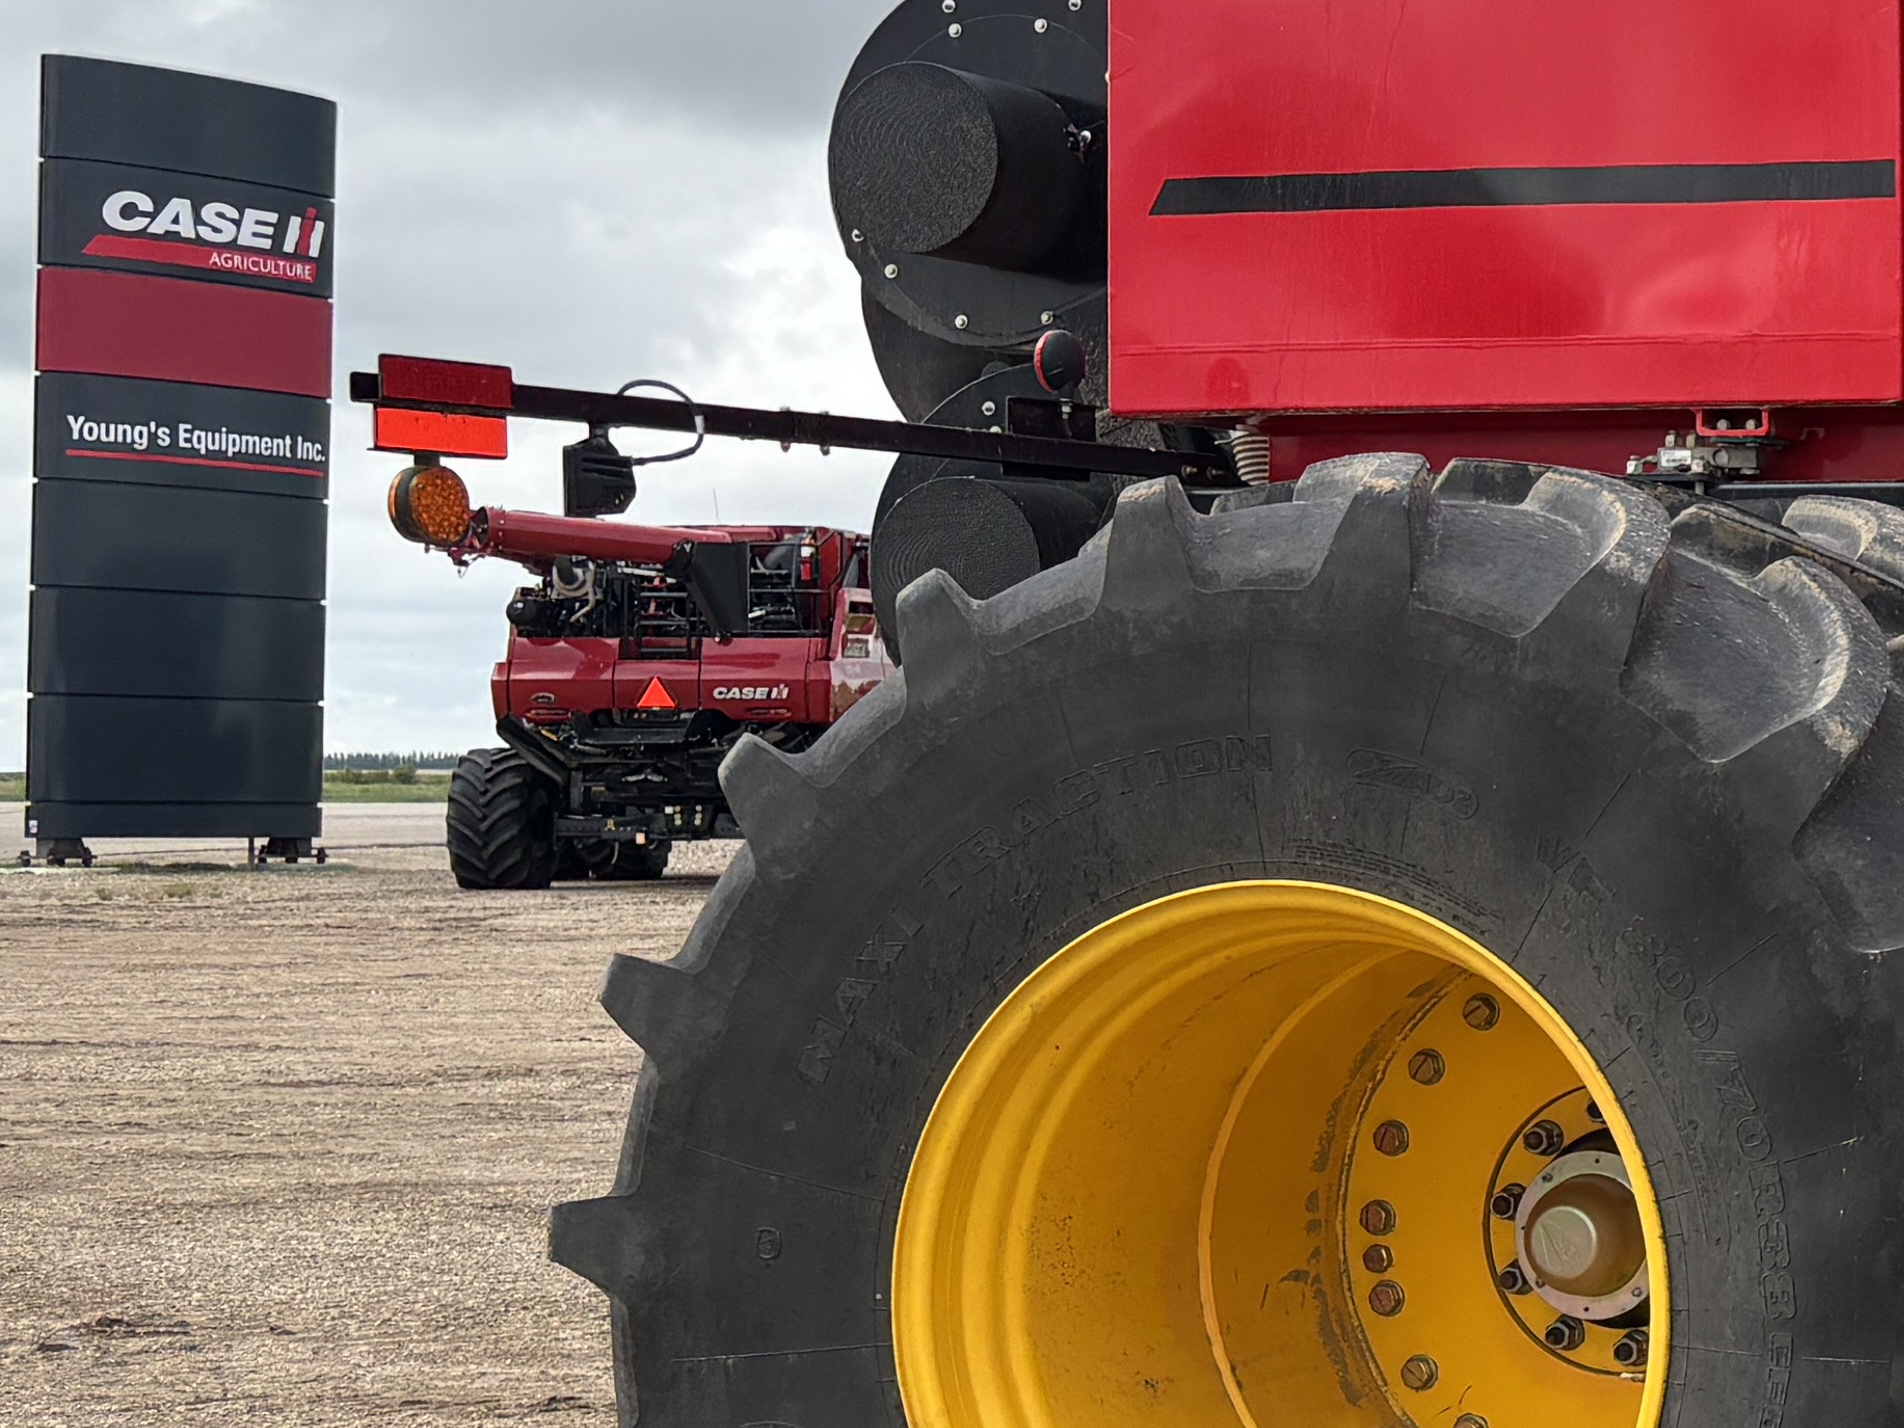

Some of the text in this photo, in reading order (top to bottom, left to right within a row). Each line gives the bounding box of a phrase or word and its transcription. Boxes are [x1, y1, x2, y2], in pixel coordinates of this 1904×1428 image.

[102, 190, 279, 250] CASE
[209, 251, 313, 281] AGRICULTURE
[66, 415, 326, 462] Young's Equipment Inc.
[712, 686, 769, 700] CASE
[917, 733, 1273, 898] TRACTION
[1613, 913, 1797, 1320] 800/70R38
